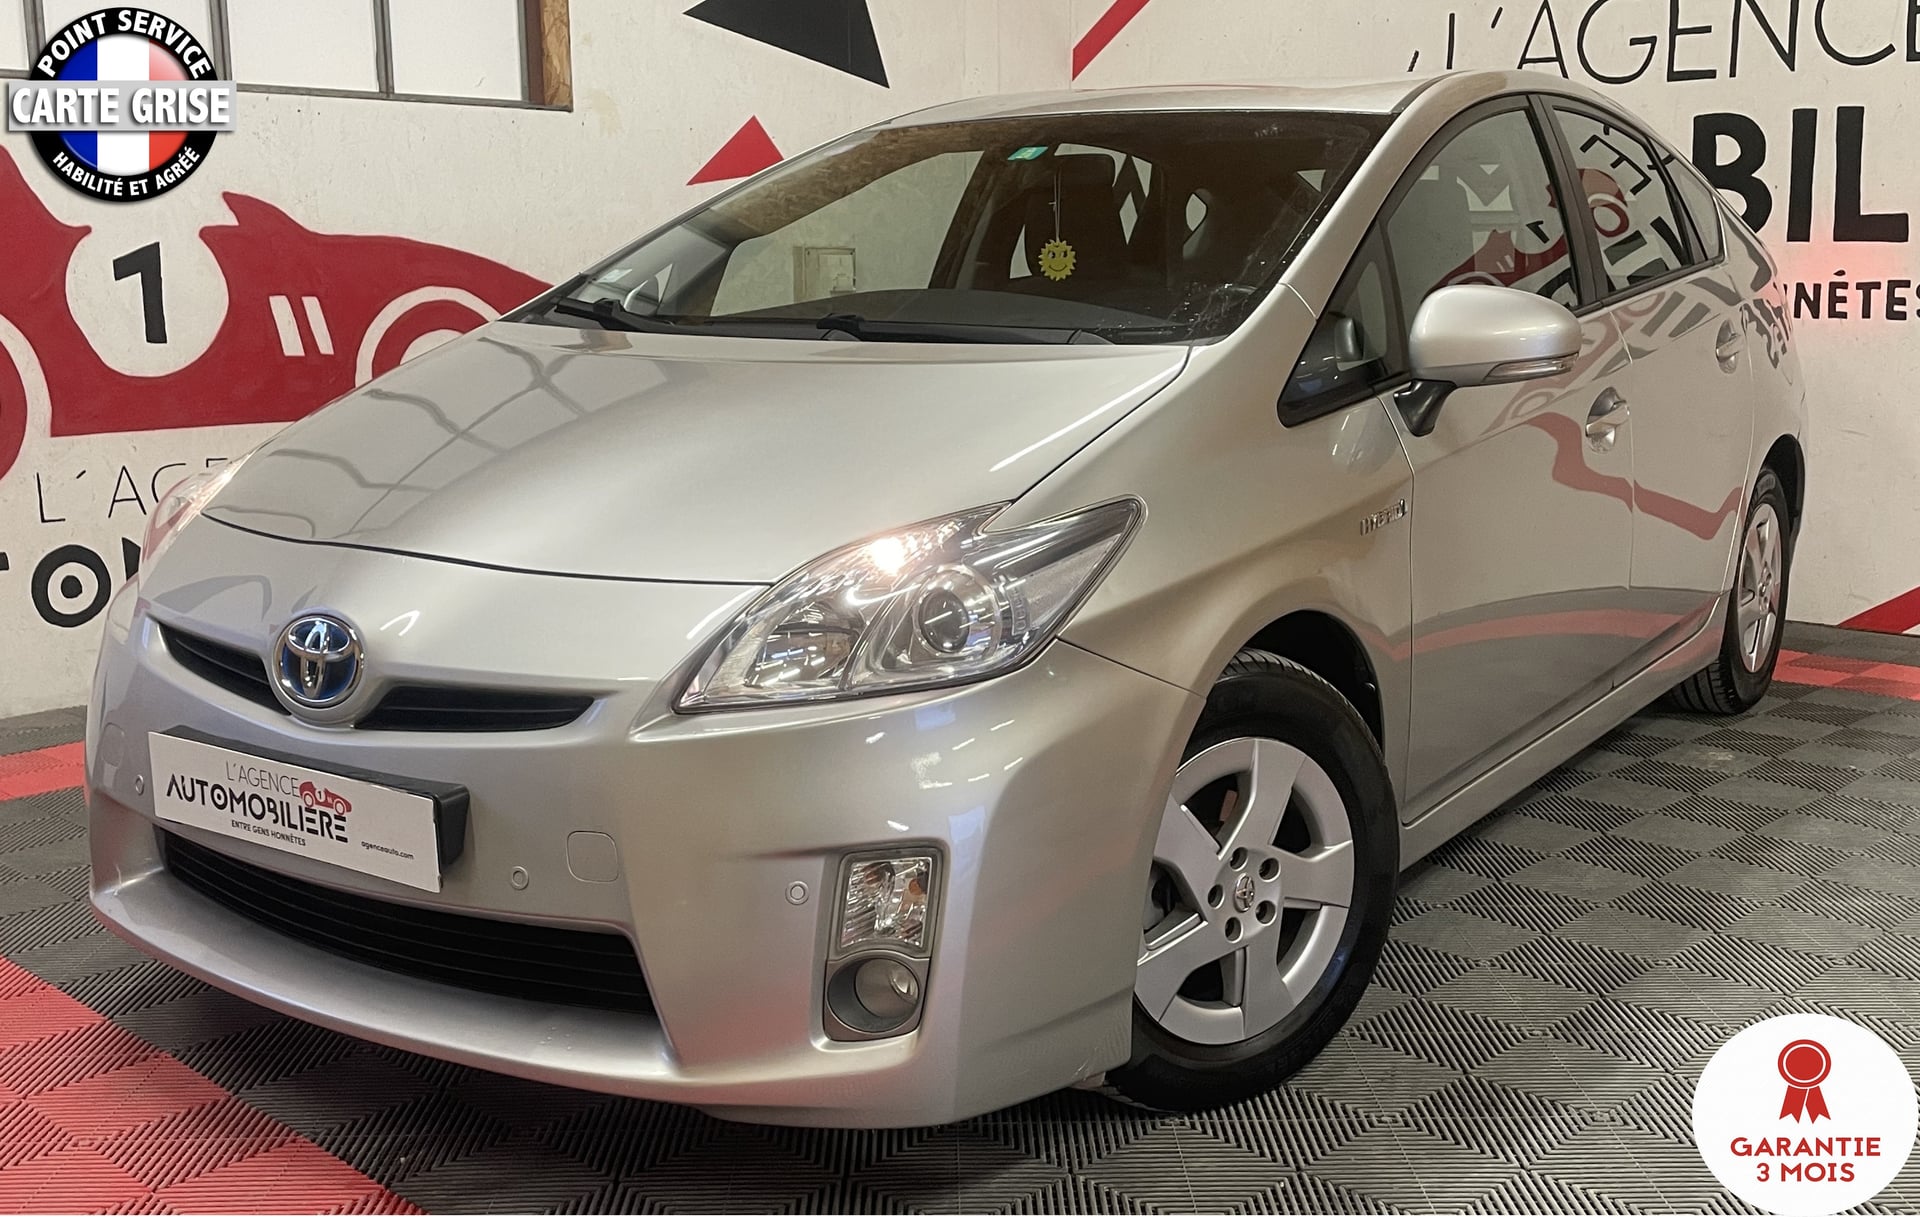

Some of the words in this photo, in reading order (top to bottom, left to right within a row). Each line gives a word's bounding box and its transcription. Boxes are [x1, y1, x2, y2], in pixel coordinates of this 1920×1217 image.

[112, 241, 168, 344] 1
[226, 761, 300, 798] L'AGENCE
[231, 819, 251, 832] ENTRE
[252, 825, 270, 837] GENS
[361, 840, 415, 860] agenceauto.com
